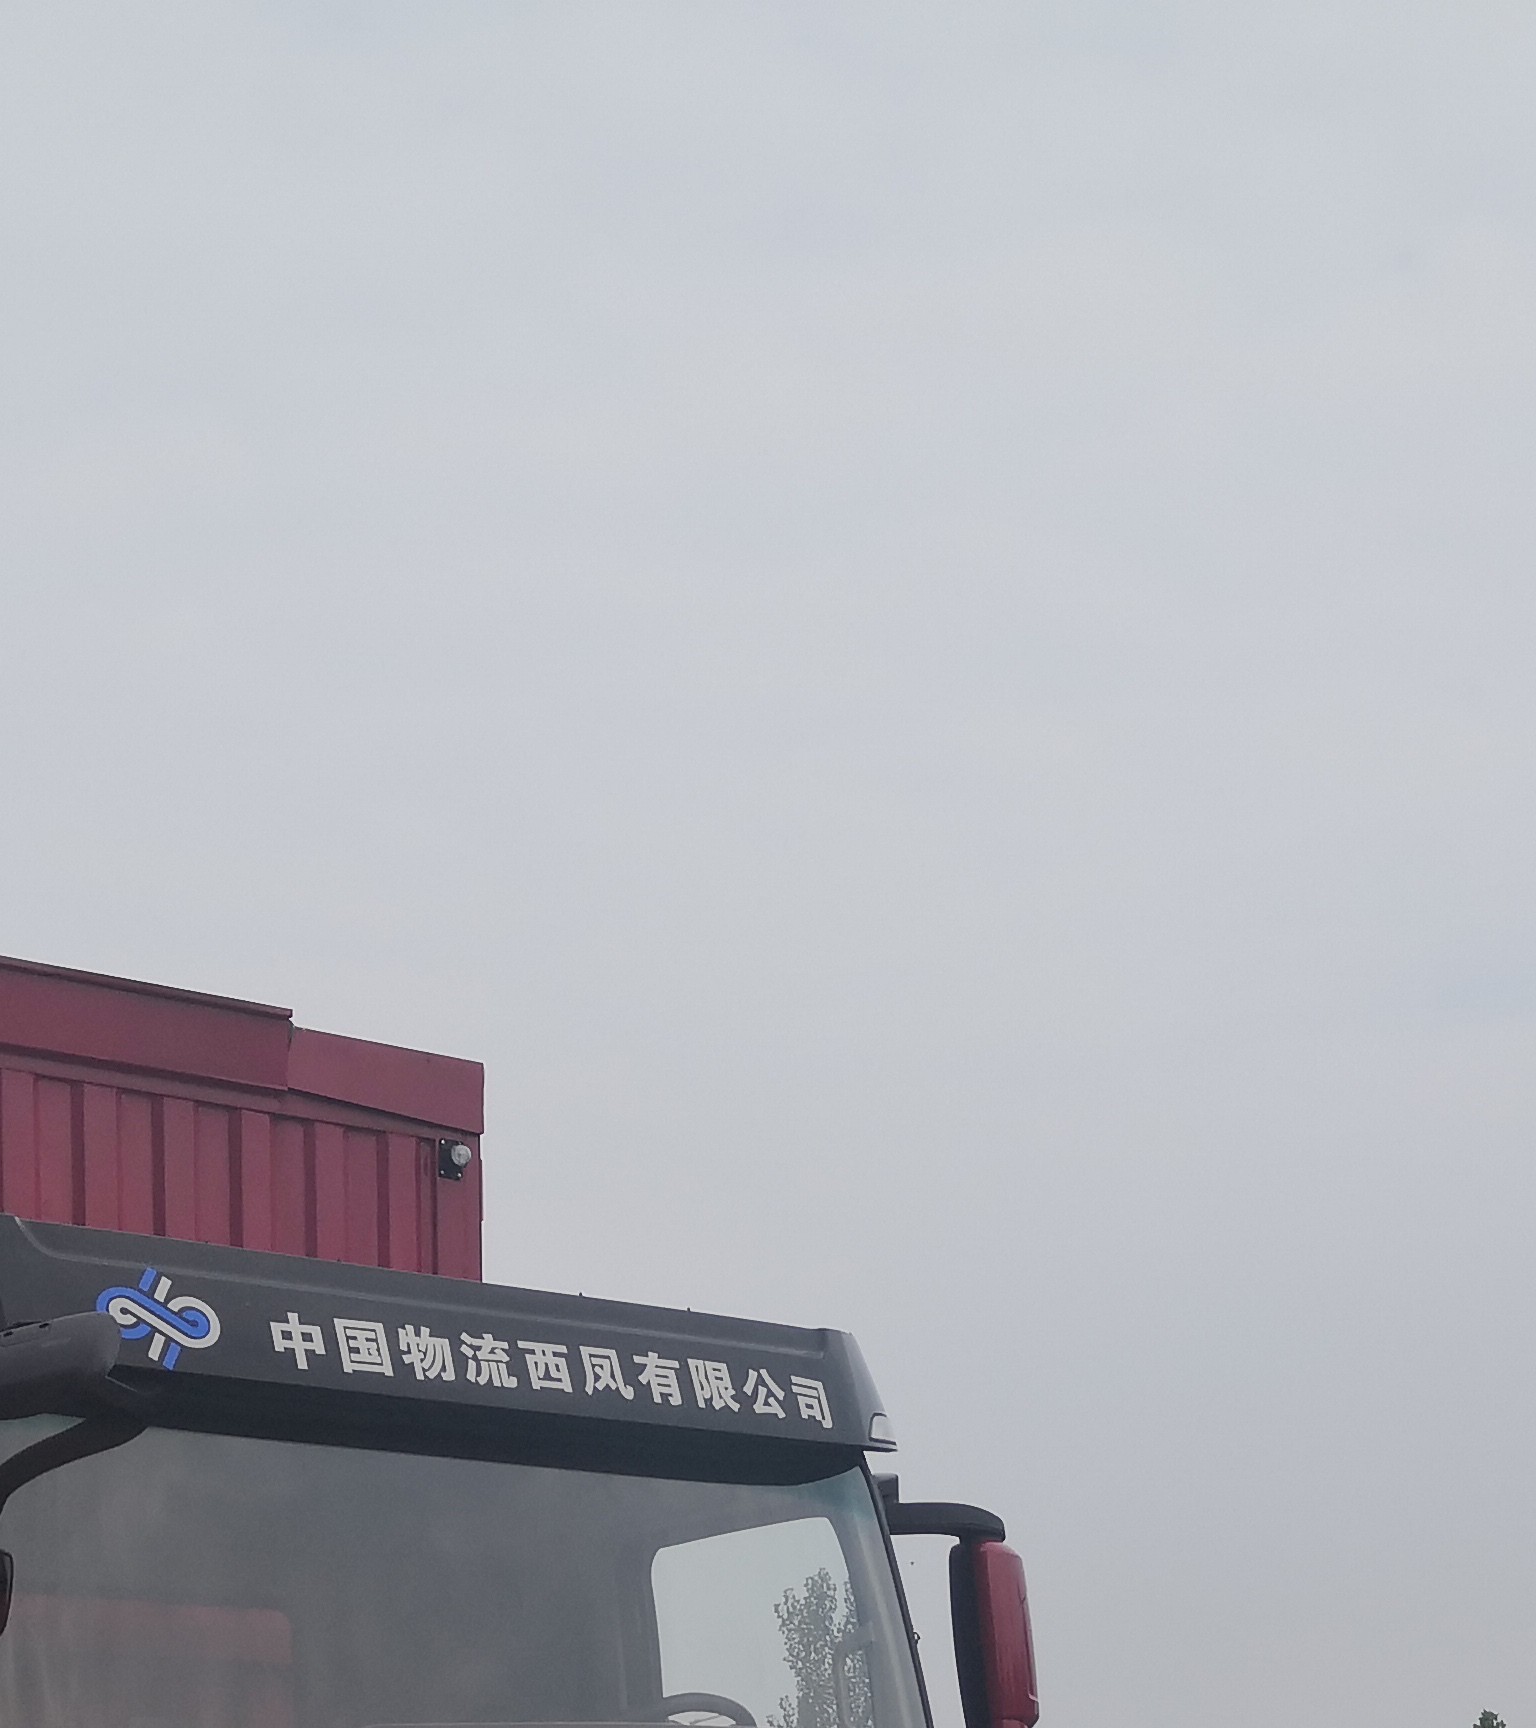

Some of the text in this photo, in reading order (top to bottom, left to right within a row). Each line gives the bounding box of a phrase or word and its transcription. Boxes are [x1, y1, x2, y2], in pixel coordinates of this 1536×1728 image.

[269, 1311, 834, 1430] 中国物流西凤有限公司
